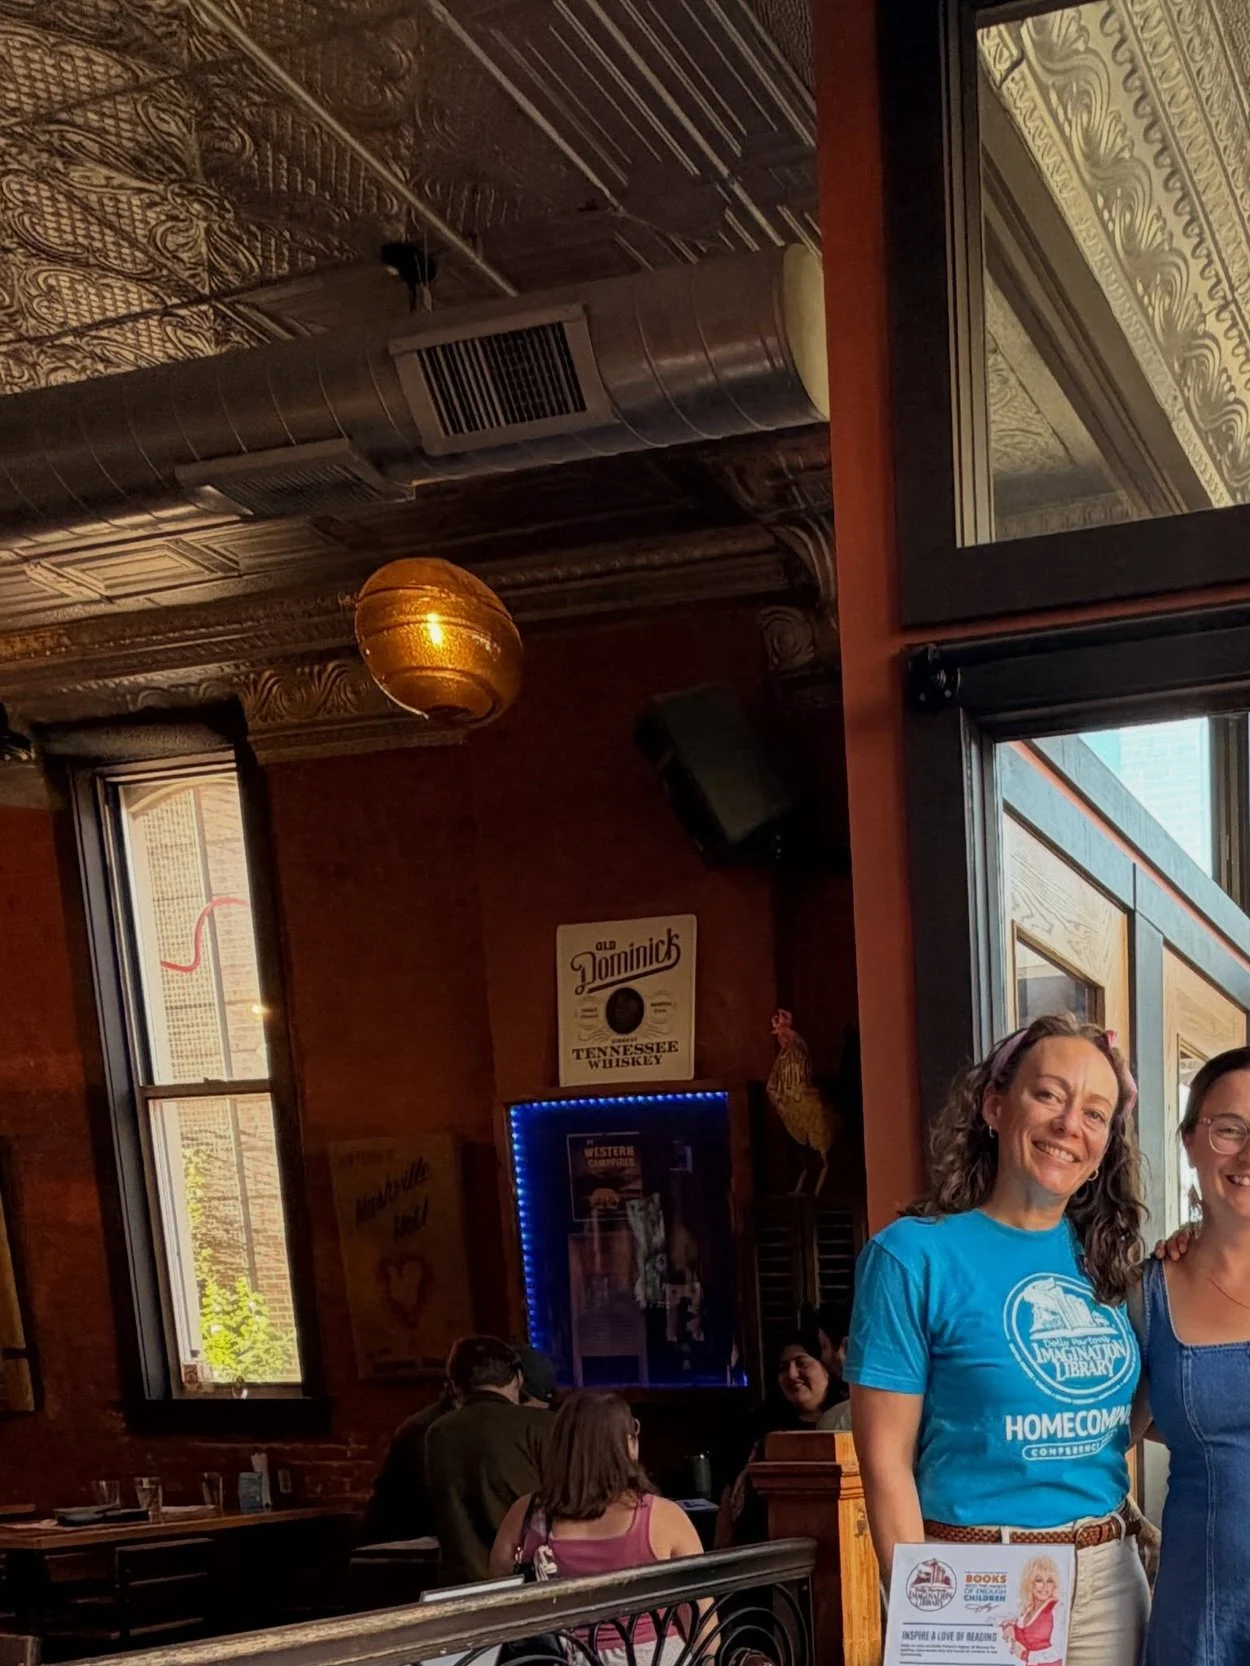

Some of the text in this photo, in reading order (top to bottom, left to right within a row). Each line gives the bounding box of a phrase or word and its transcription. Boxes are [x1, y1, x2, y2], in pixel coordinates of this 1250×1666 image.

[595, 940, 617, 951] OLD
[570, 927, 682, 996] Dominick
[572, 1040, 679, 1061] TENNESSEE
[588, 1054, 663, 1070] WHISKEY
[584, 1145, 635, 1158] WESTERN
[1031, 1338, 1128, 1364] IMAGINATION
[1042, 1336, 1070, 1351] Dolly
[1052, 1359, 1116, 1382] LIBRARY
[1005, 1404, 1132, 1442] HOMECOMIN
[965, 1574, 1007, 1584] BOOKS
[963, 1594, 1006, 1602] CHILDREN
[901, 1630, 997, 1642] INSPIRE A LOVE OF READING
